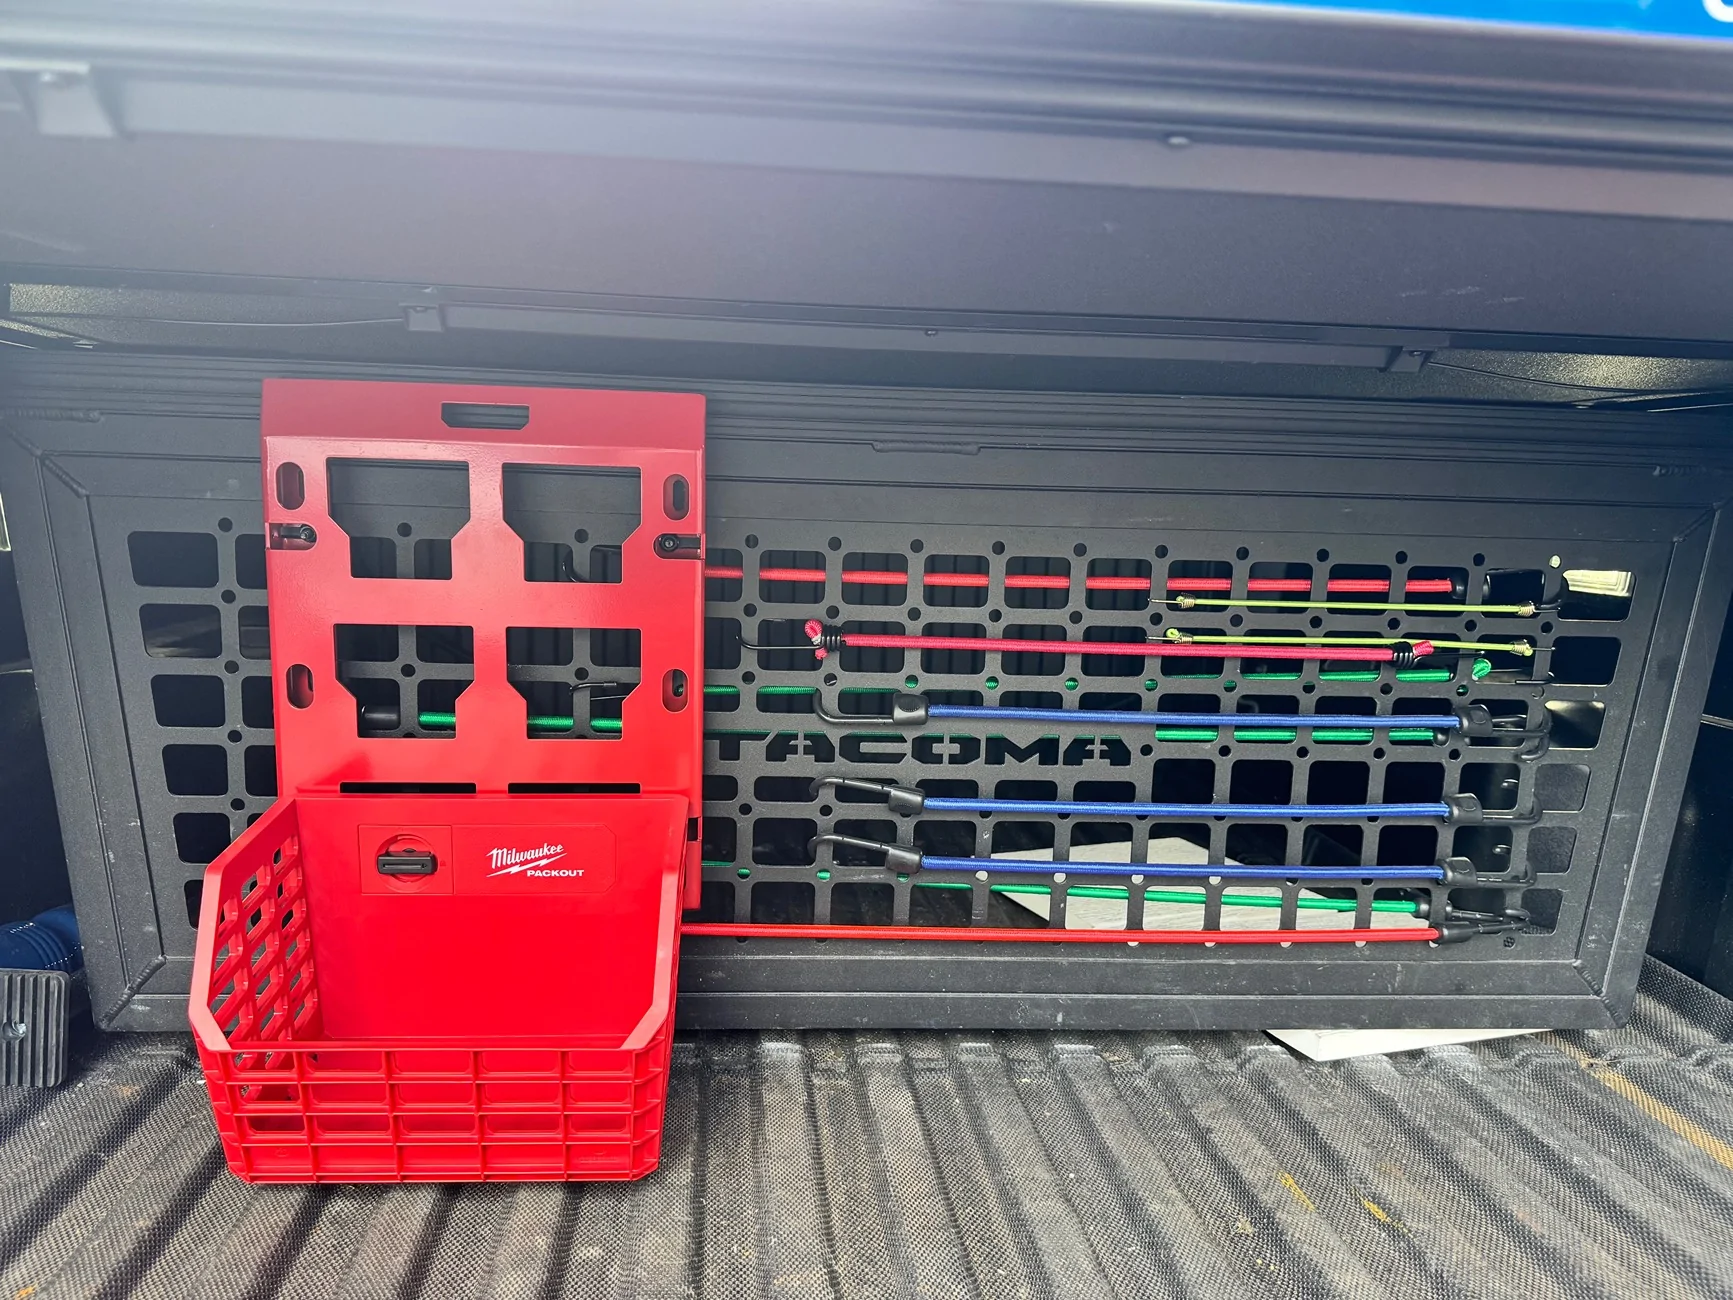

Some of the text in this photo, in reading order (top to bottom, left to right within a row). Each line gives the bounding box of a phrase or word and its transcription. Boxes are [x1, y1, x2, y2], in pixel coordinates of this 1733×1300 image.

[703, 729, 1132, 766] TACOMA
[486, 843, 564, 869] Milwaukee
[526, 869, 585, 877] PACKOUT
